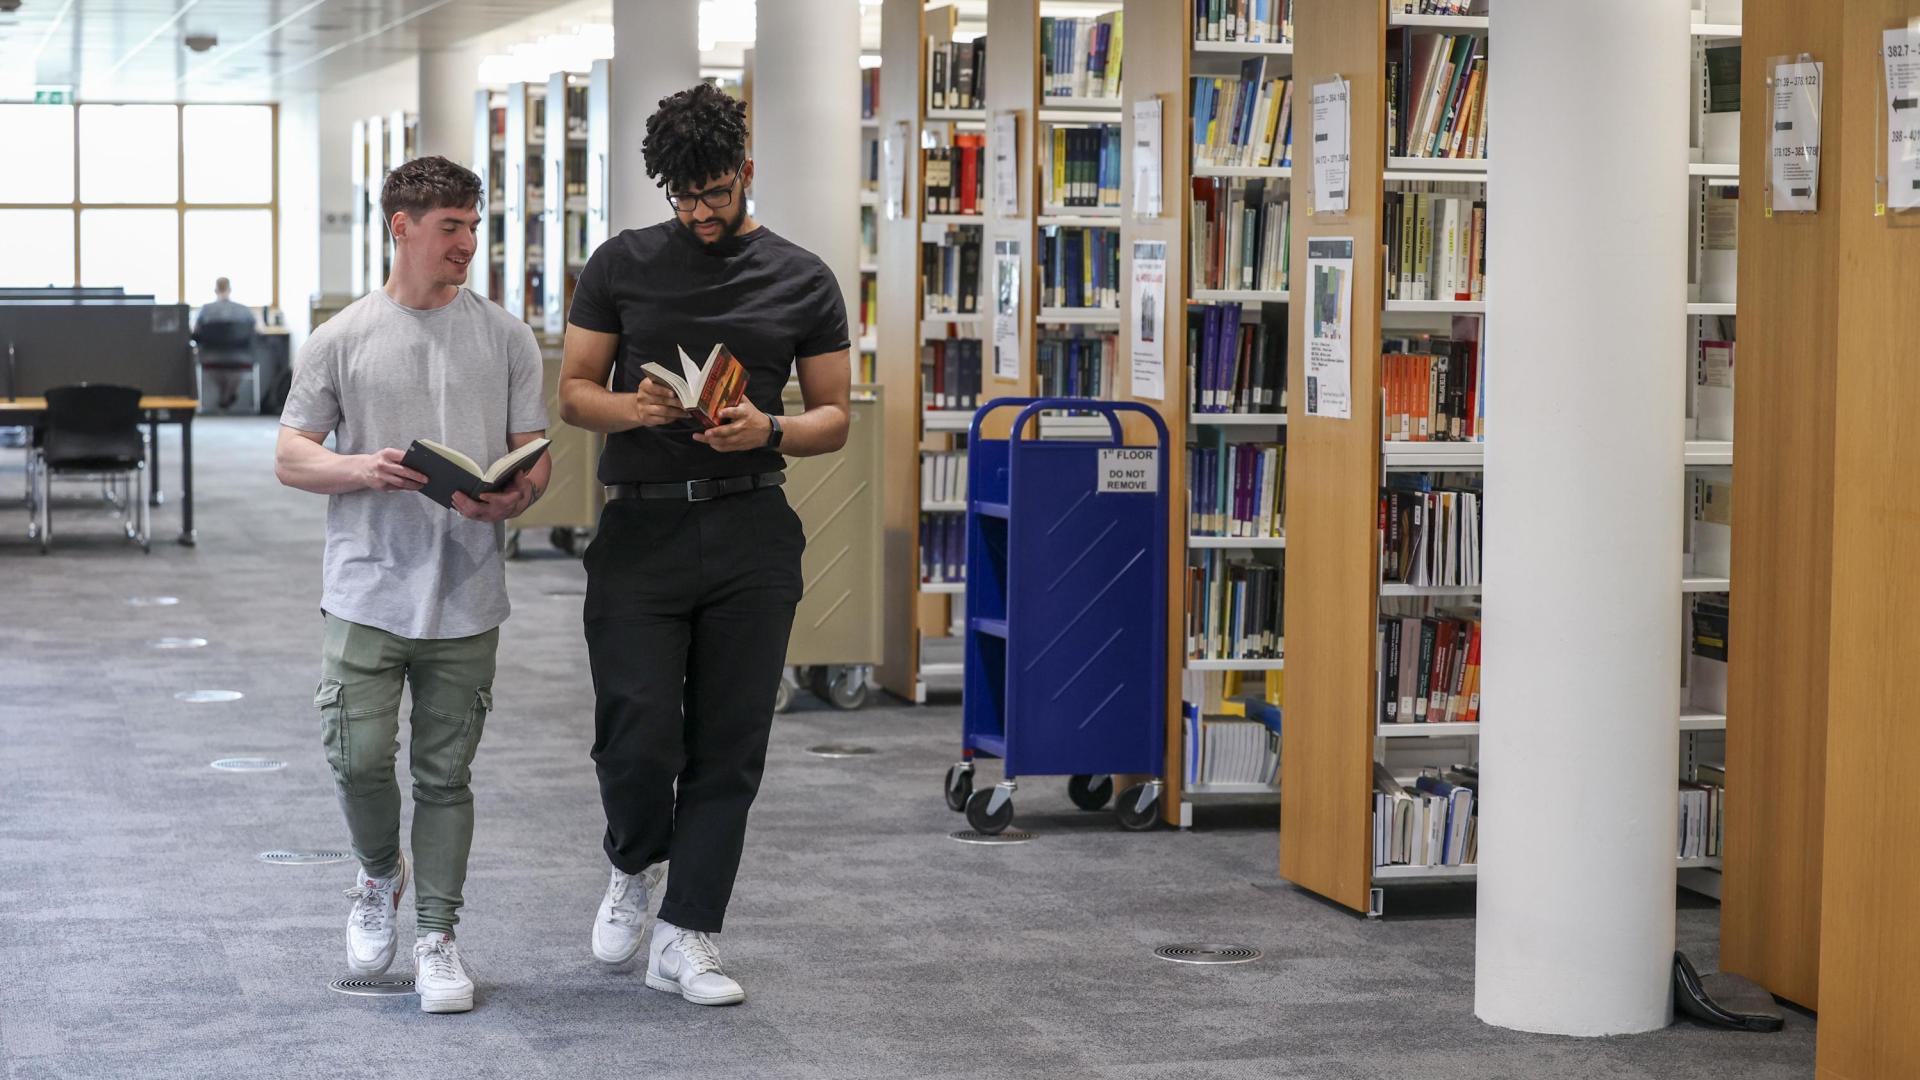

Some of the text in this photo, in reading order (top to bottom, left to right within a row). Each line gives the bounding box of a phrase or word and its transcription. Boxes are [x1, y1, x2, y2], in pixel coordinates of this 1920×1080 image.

[1887, 44, 1909, 58] 382.7
[1117, 451, 1153, 460] FLOOR
[1109, 470, 1145, 478] DO NOT
[1107, 481, 1147, 489] REMOVE
